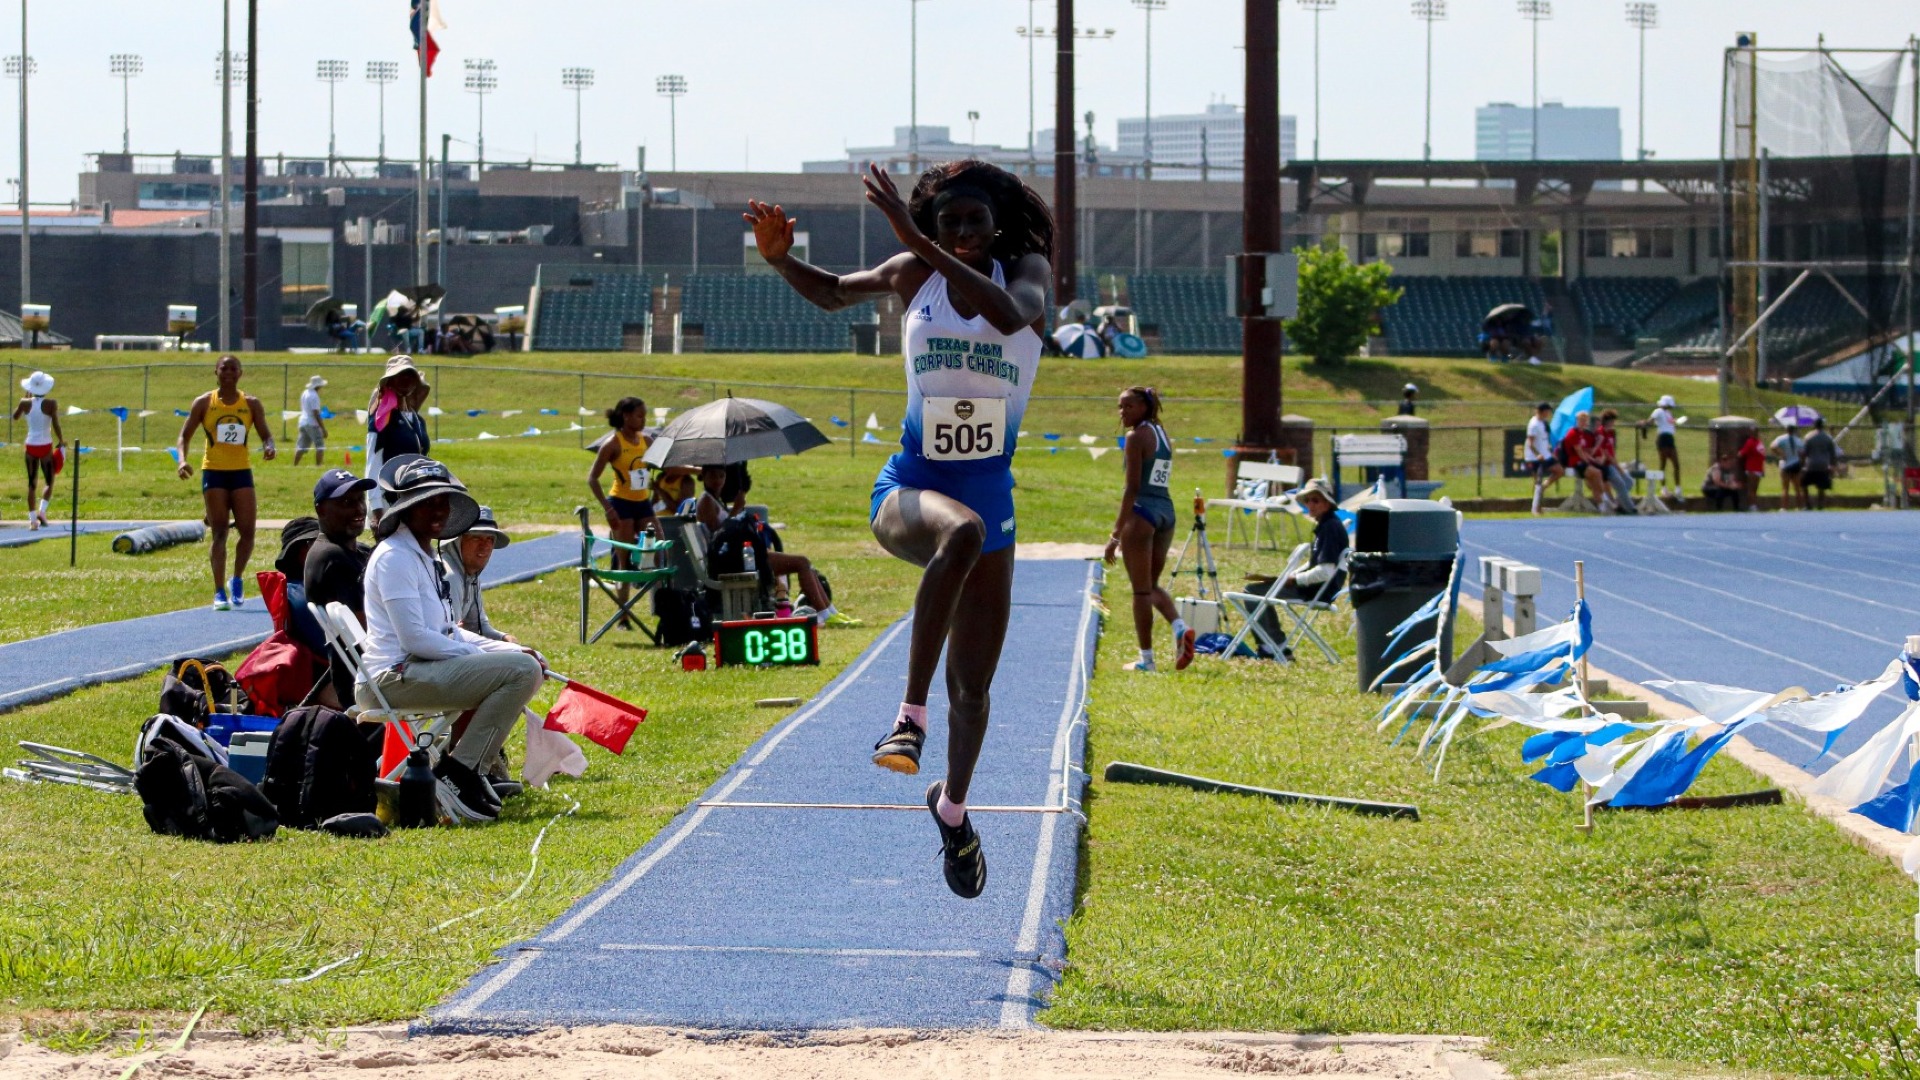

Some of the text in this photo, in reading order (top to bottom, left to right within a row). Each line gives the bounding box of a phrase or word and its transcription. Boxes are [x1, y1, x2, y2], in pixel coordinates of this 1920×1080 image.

[927, 337, 1003, 359] TEXAS A&M
[914, 353, 1020, 386] CORPUS CHRISTI
[224, 431, 238, 442] 22
[934, 422, 993, 454] 505
[639, 476, 645, 487] 7
[744, 628, 807, 663] 0:38
